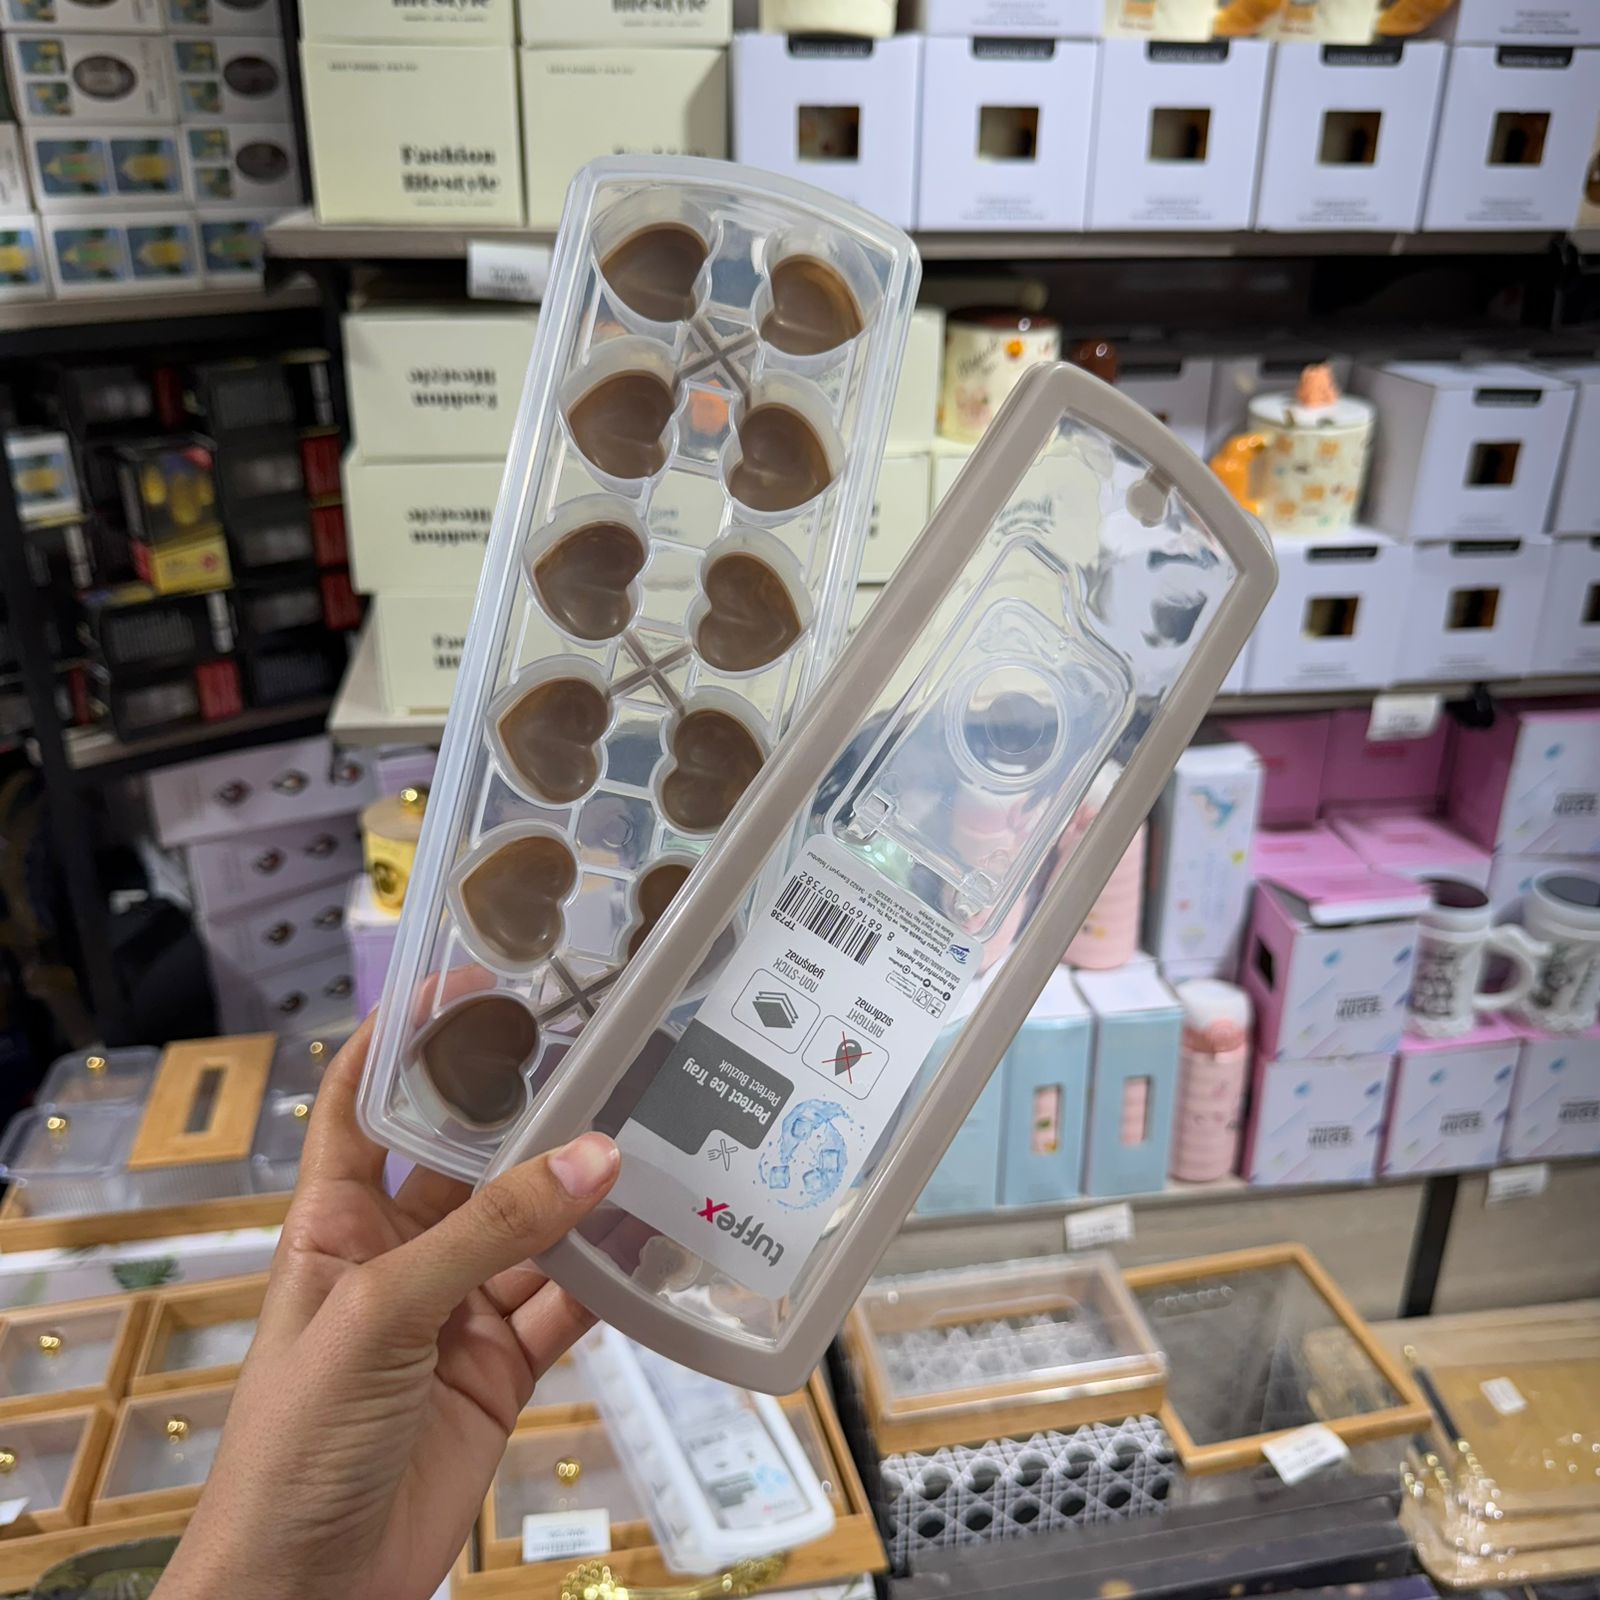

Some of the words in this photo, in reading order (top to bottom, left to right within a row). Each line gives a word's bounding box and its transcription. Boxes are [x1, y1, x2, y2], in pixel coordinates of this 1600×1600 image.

[798, 870, 839, 903] 007382
[770, 908, 795, 931] TP738
[841, 900, 882, 931] 681690
[918, 909, 935, 925] Türkiye
[886, 931, 895, 941] 8
[908, 930, 926, 945] Plastik
[940, 925, 954, 937] Made
[784, 948, 825, 979] yapışmaz
[895, 946, 915, 963] health.
[914, 960, 925, 969] for
[922, 966, 948, 985] harmful
[946, 981, 956, 990] No
[845, 1007, 885, 1038] AIRTIGHT
[854, 996, 893, 1026] sızdırmaz
[682, 1057, 709, 1086] Tray
[718, 1059, 749, 1086] Buzluk
[709, 1076, 729, 1098] Ice
[748, 1078, 781, 1107] Perfect
[727, 1088, 771, 1125] Perfect
[695, 1196, 784, 1266] tuffex
